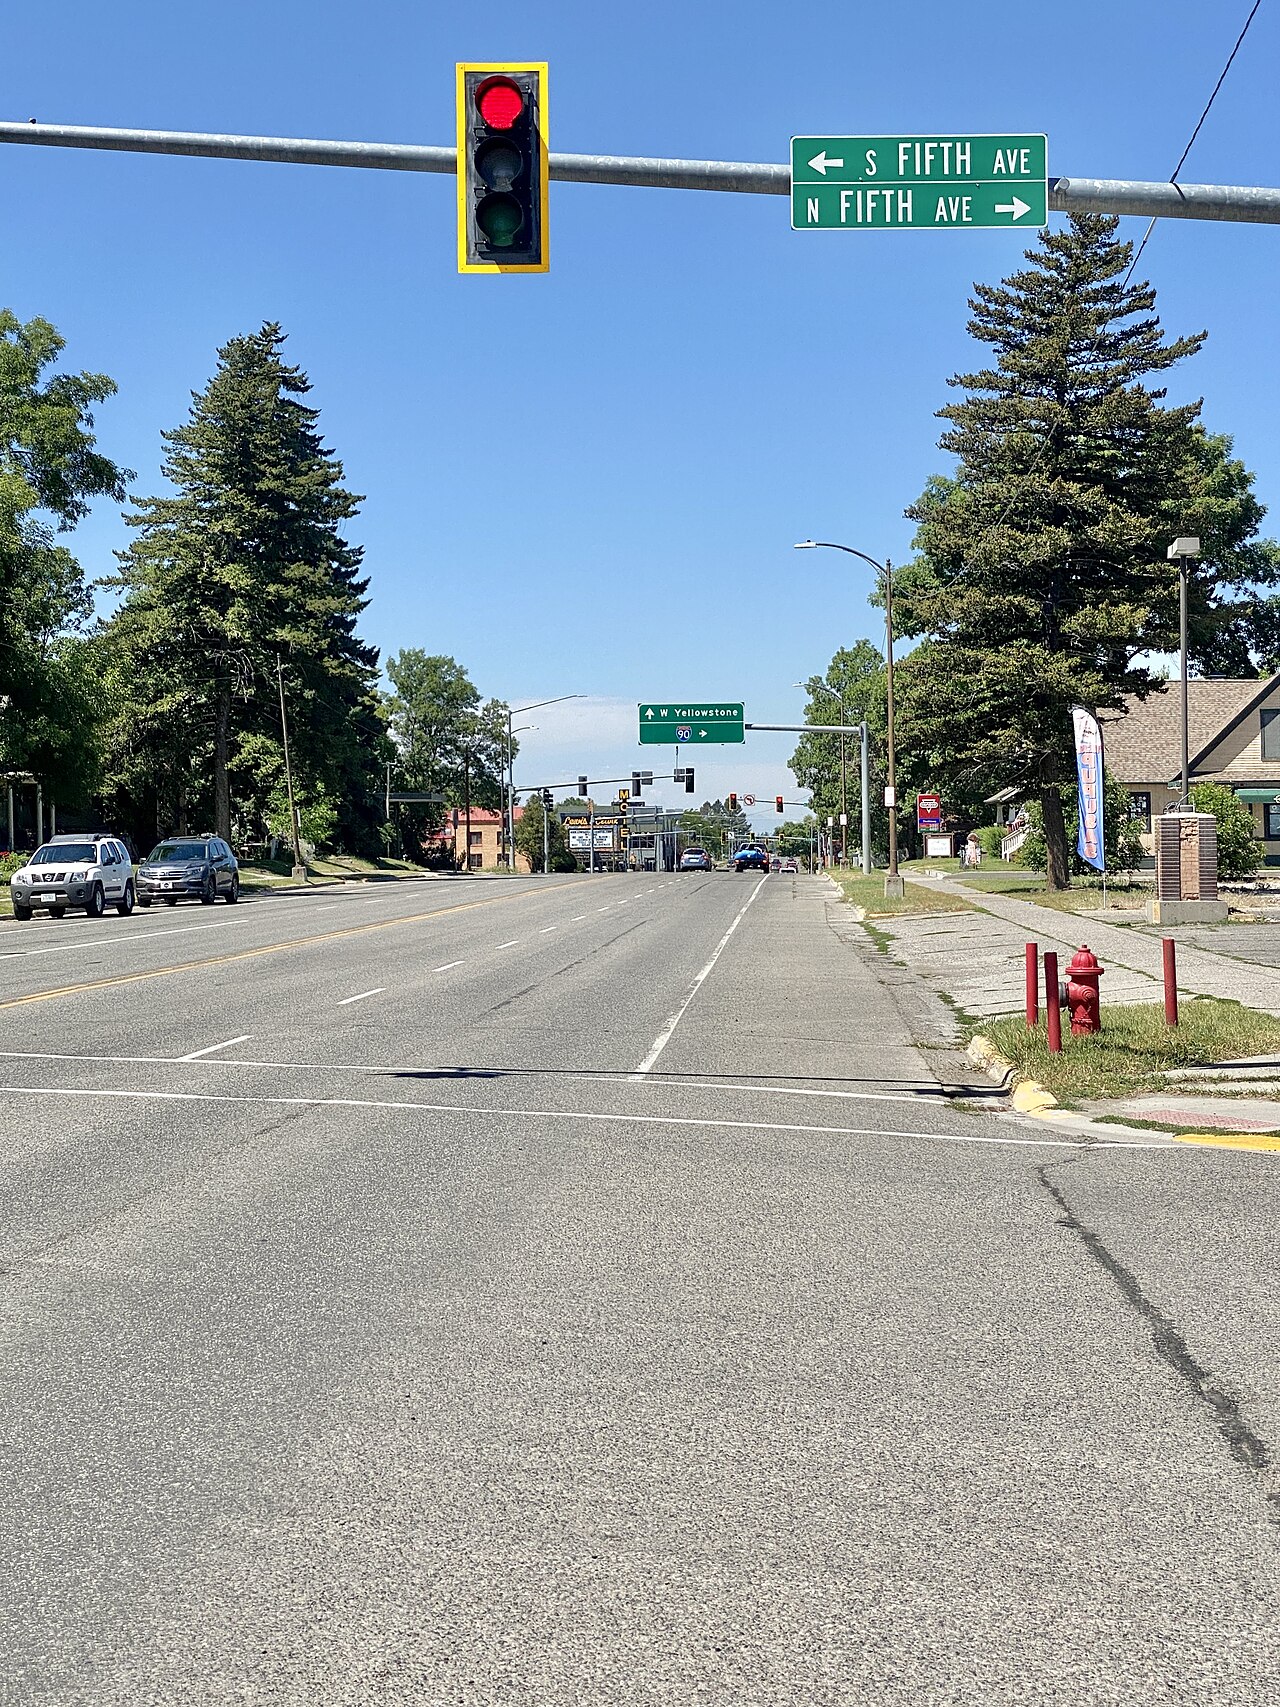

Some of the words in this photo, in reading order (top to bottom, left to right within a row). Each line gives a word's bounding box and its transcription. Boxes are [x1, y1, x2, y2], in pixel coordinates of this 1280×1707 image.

[865, 149, 877, 176] S
[898, 142, 971, 175] FIFTH
[993, 149, 1030, 174] AVE
[807, 197, 819, 223] N
[840, 190, 913, 223] FIFTH
[934, 196, 973, 222] AVE
[660, 708, 669, 717] W
[674, 708, 739, 717] Yellowstone
[677, 730, 690, 739] 90
